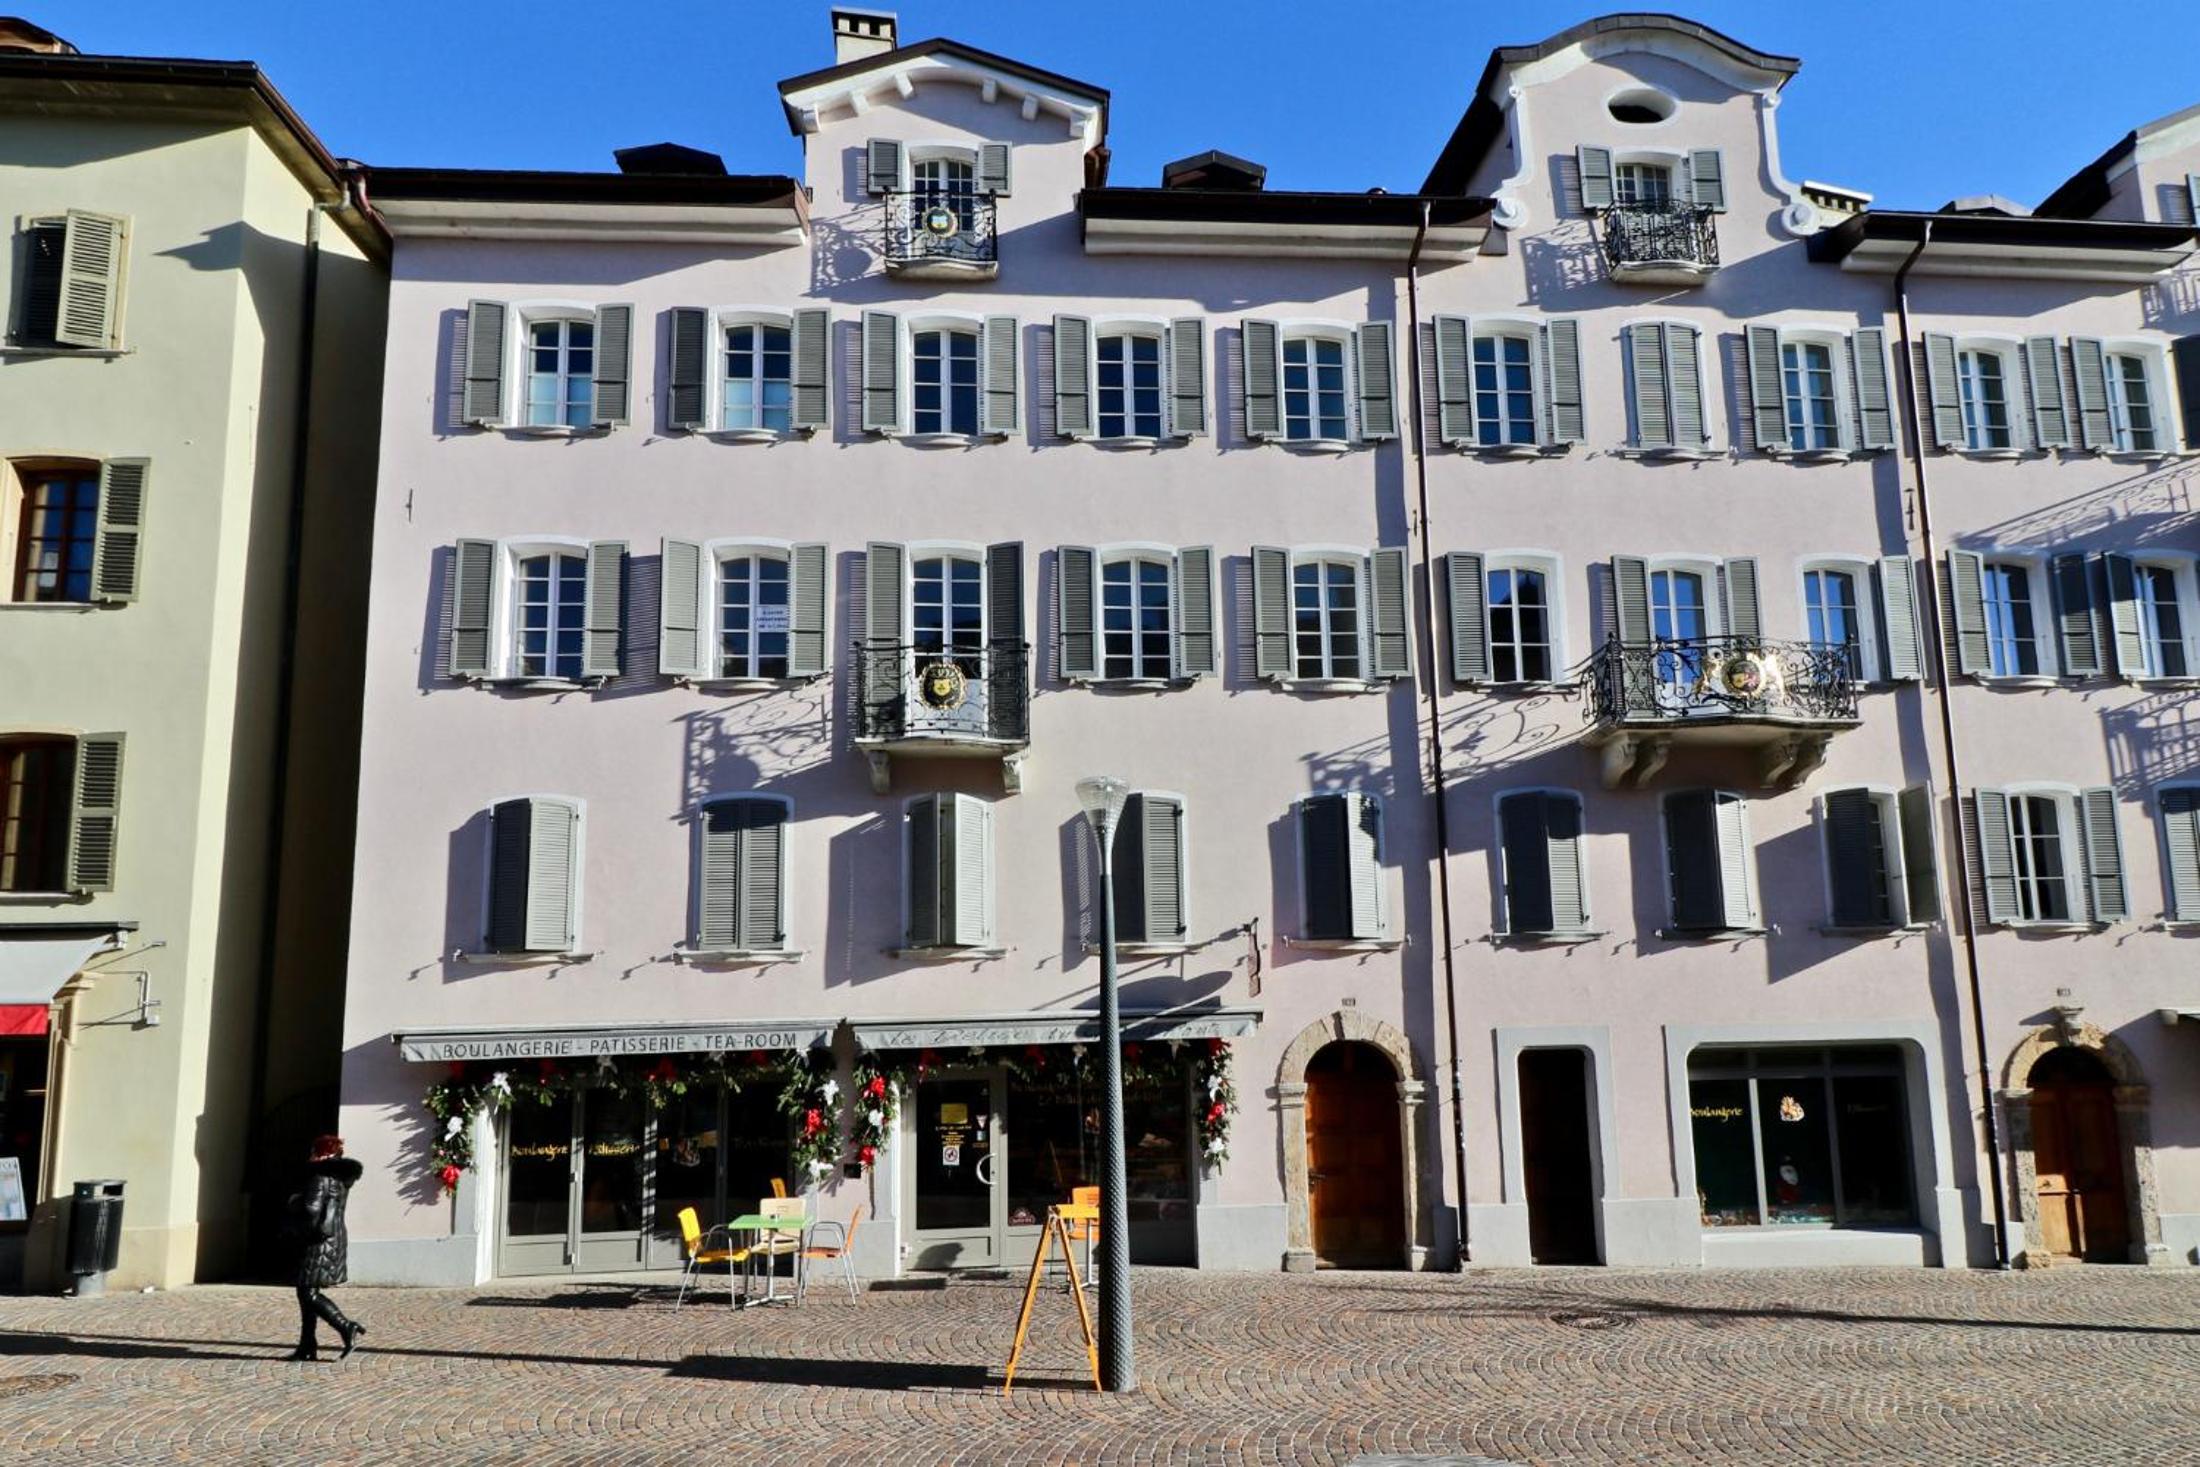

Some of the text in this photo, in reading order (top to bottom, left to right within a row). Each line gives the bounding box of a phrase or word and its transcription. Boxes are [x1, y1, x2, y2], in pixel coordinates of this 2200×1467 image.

[443, 1041, 570, 1058] BOULANGERIE
[590, 1036, 686, 1053] PATISSERIE
[704, 1033, 797, 1049] TEA-ROOM
